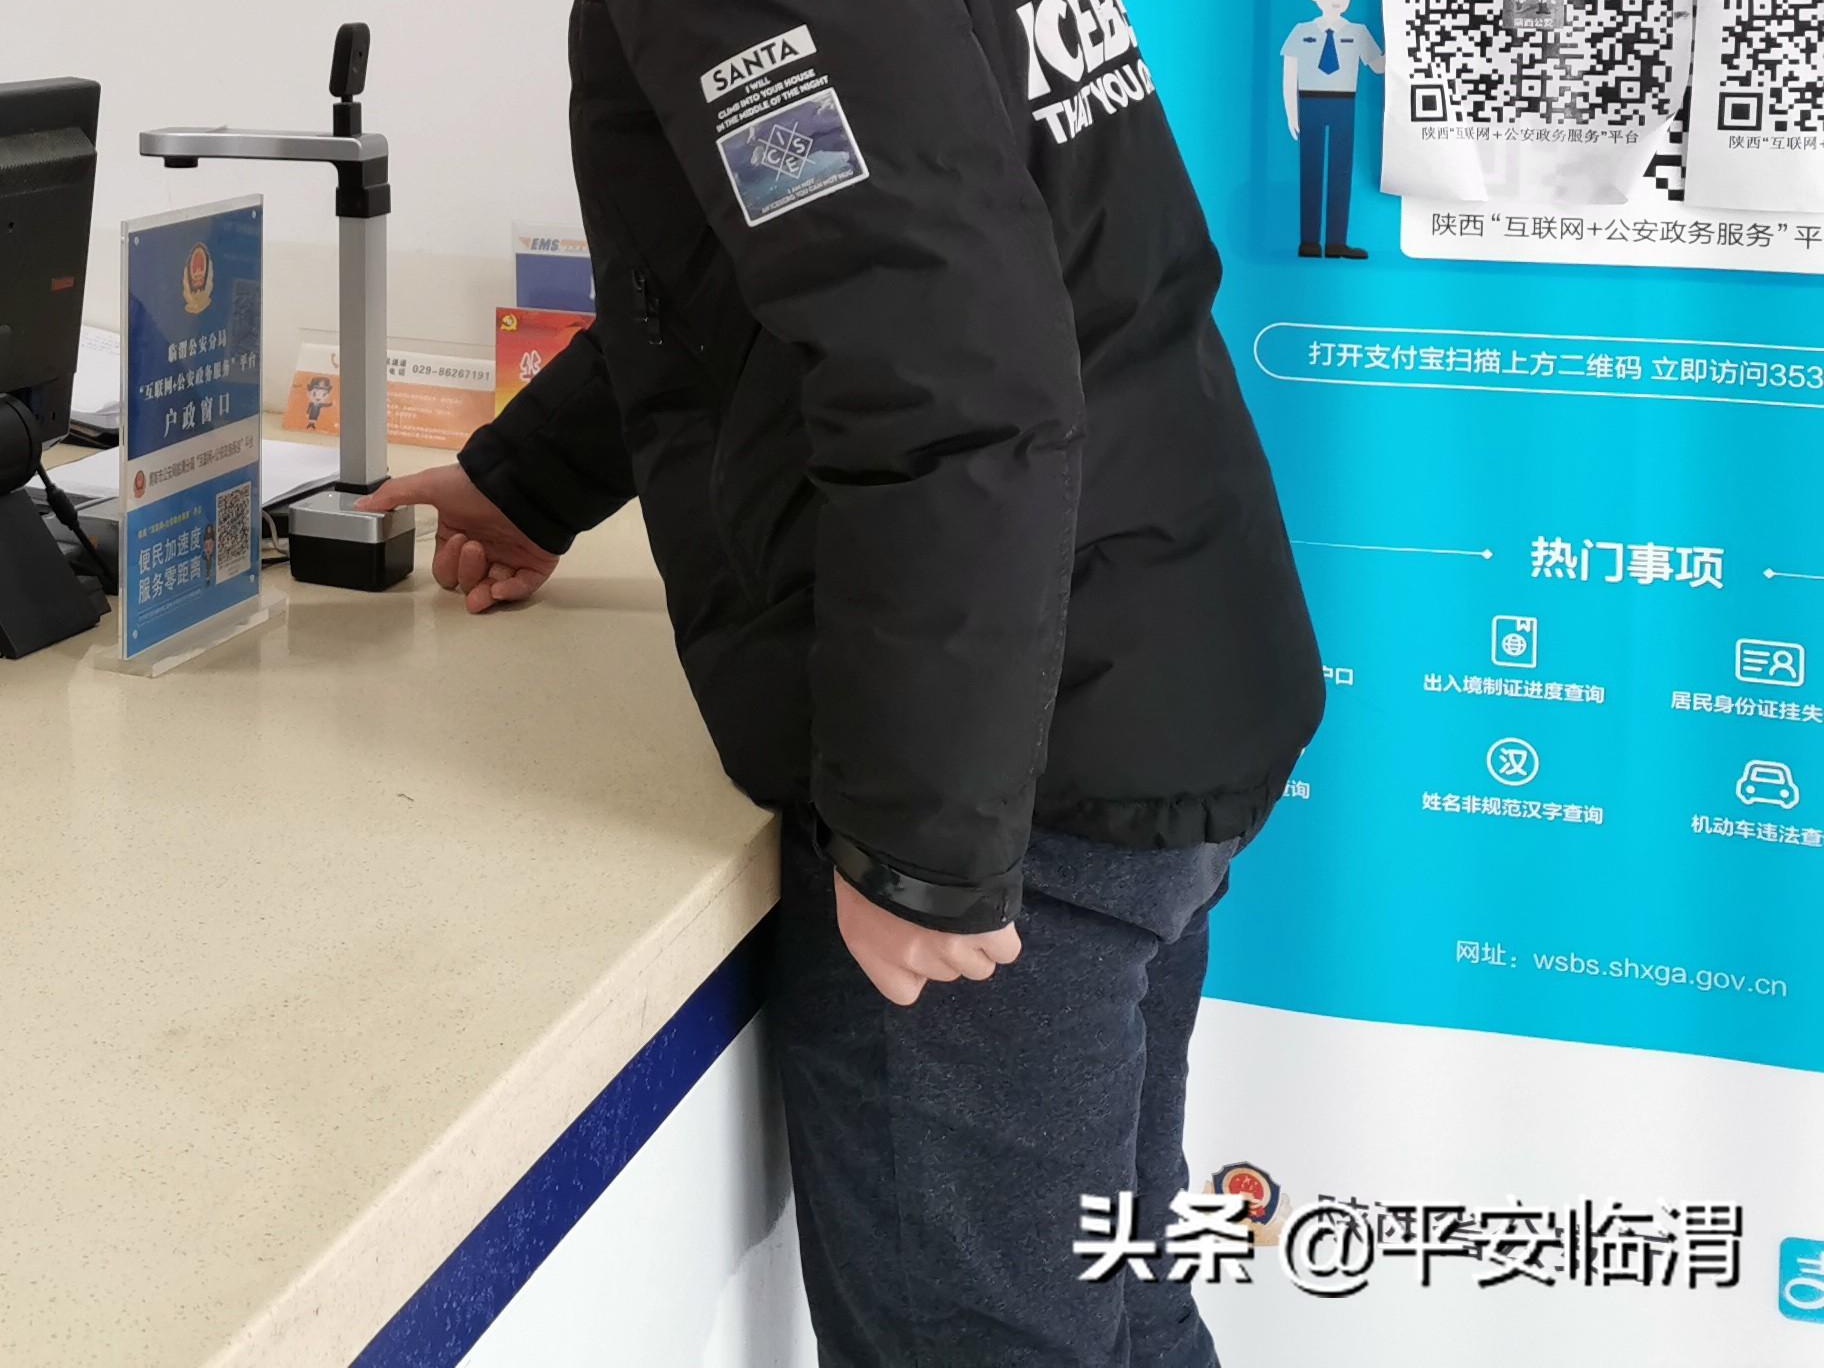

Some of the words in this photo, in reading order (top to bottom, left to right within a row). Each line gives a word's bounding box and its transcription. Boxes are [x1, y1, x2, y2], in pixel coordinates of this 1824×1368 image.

[713, 38, 799, 92] SANTA
[530, 237, 560, 251] EMS
[412, 364, 490, 382] 029-86267191
[1308, 341, 1642, 381] 打开支付宝扫描上方二维码
[1651, 356, 1824, 390] 立即访问353
[164, 392, 230, 439] 户政窗口
[139, 526, 202, 575] 便民加速度
[1530, 535, 1725, 590] 热门事项
[138, 555, 202, 604] 服务零距离
[1423, 673, 1606, 705] 出入境制证进度查询
[1671, 690, 1824, 724] 居民身份证挂失
[1422, 792, 1604, 826] 姓名非规范汉字查询
[1691, 814, 1824, 848] 机动车违法查
